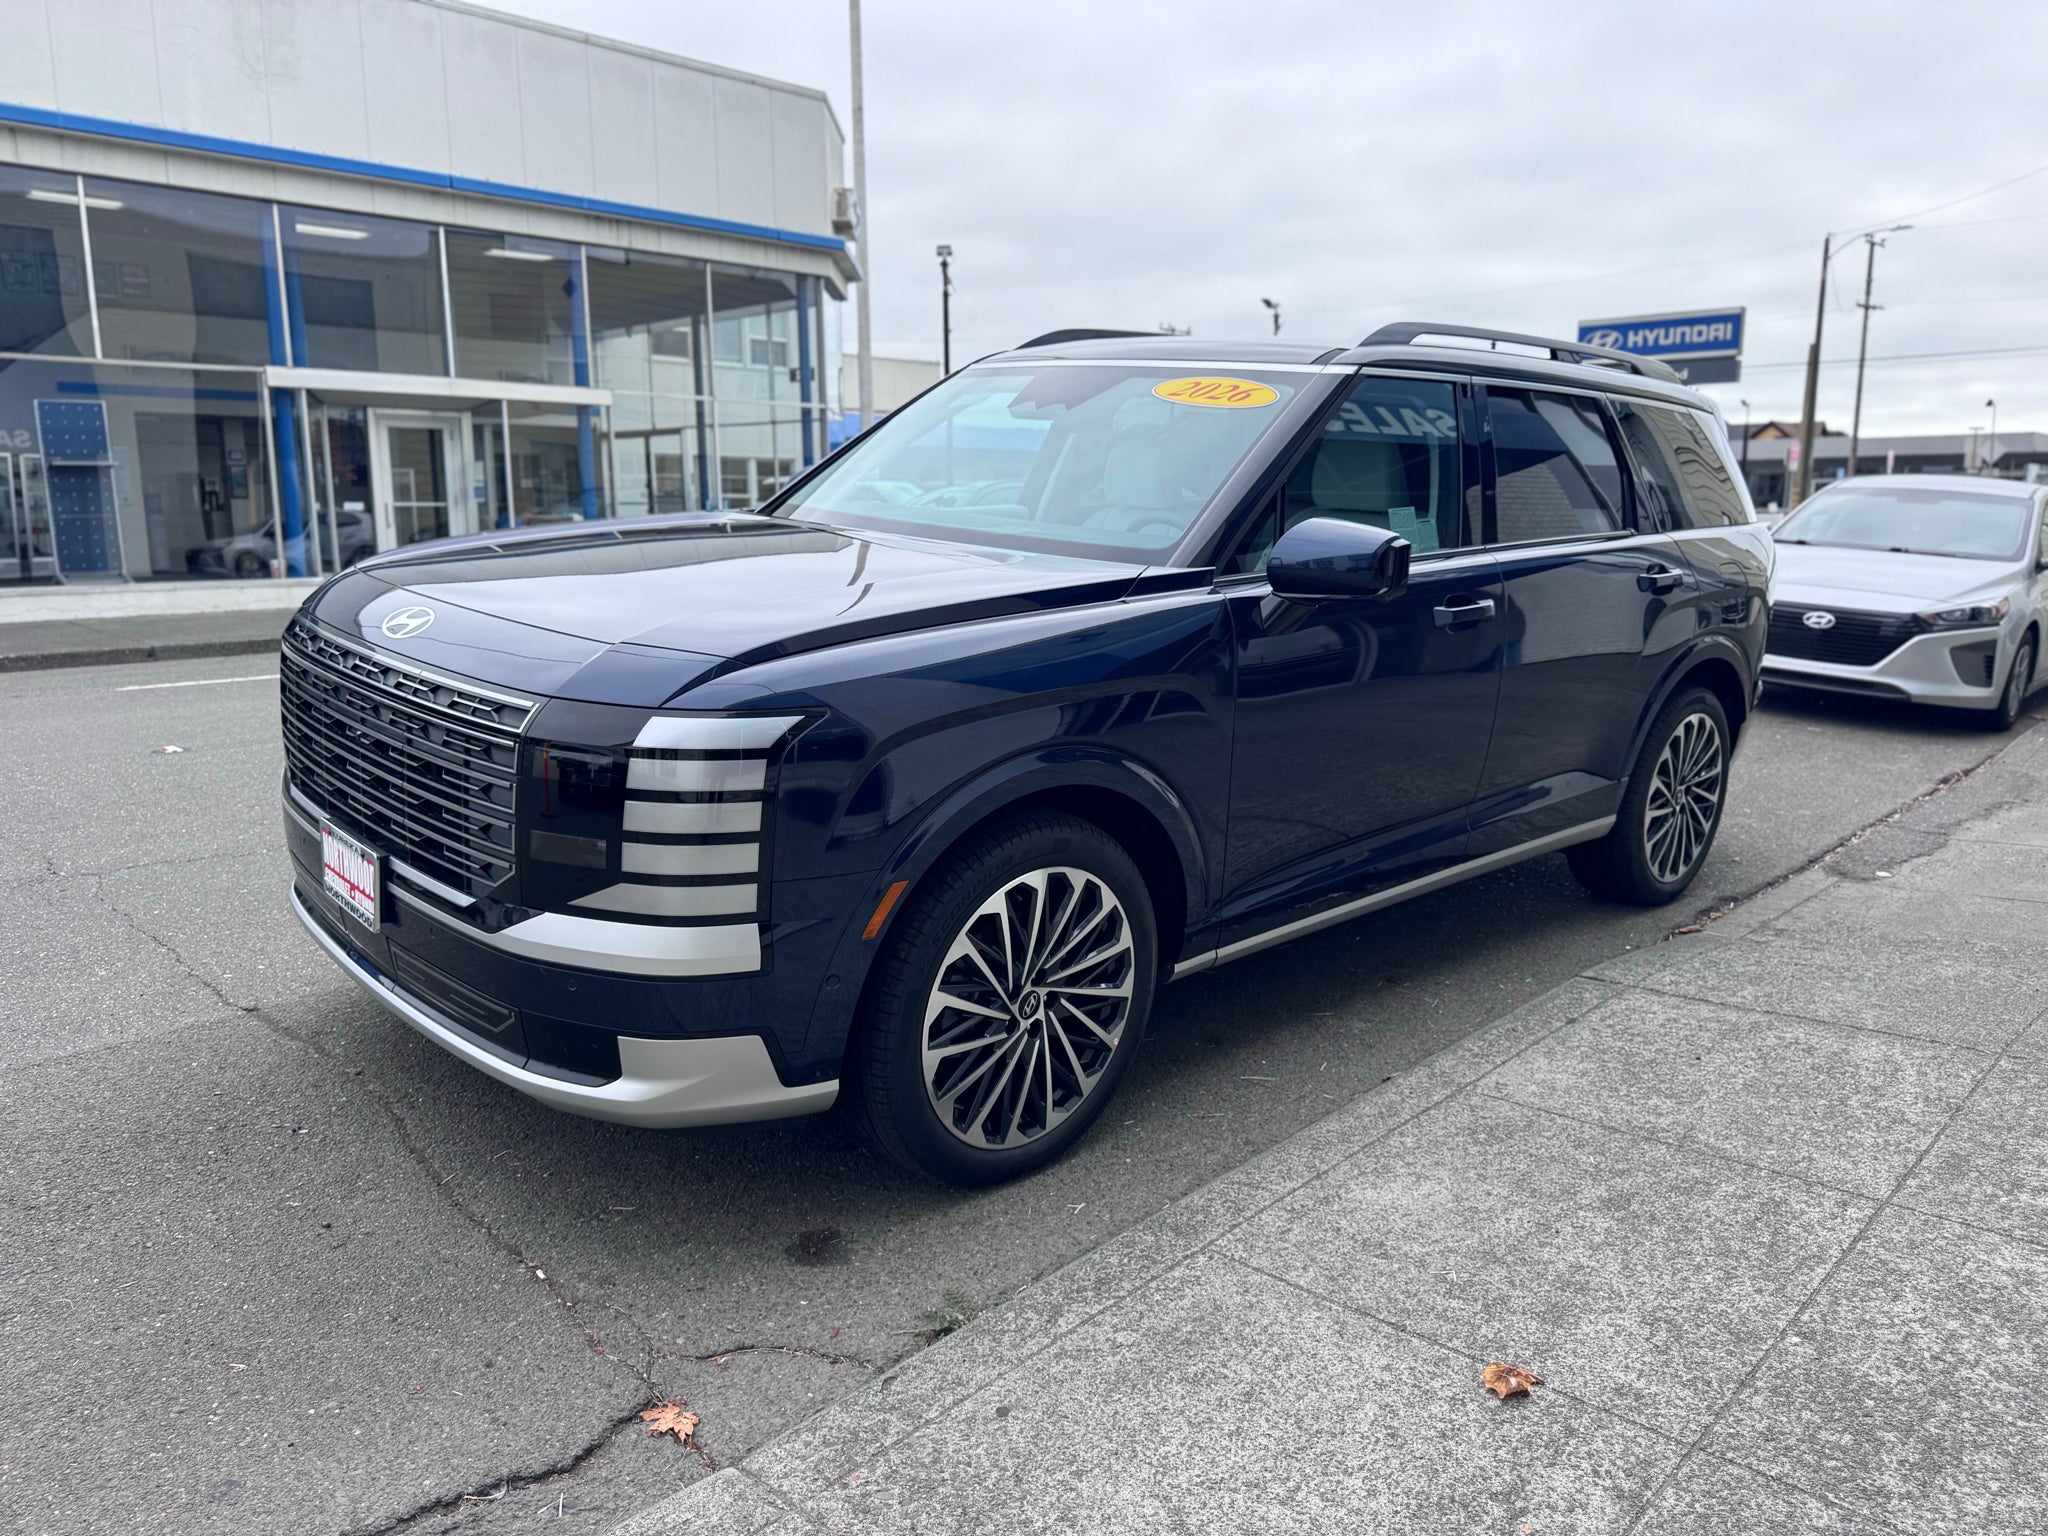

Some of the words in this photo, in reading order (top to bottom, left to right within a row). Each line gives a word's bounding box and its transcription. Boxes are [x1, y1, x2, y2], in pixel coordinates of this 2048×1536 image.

[1628, 323, 1732, 347] HYUNDAI
[1168, 381, 1264, 402] 2026
[325, 884, 373, 928] NORTHWOOD
